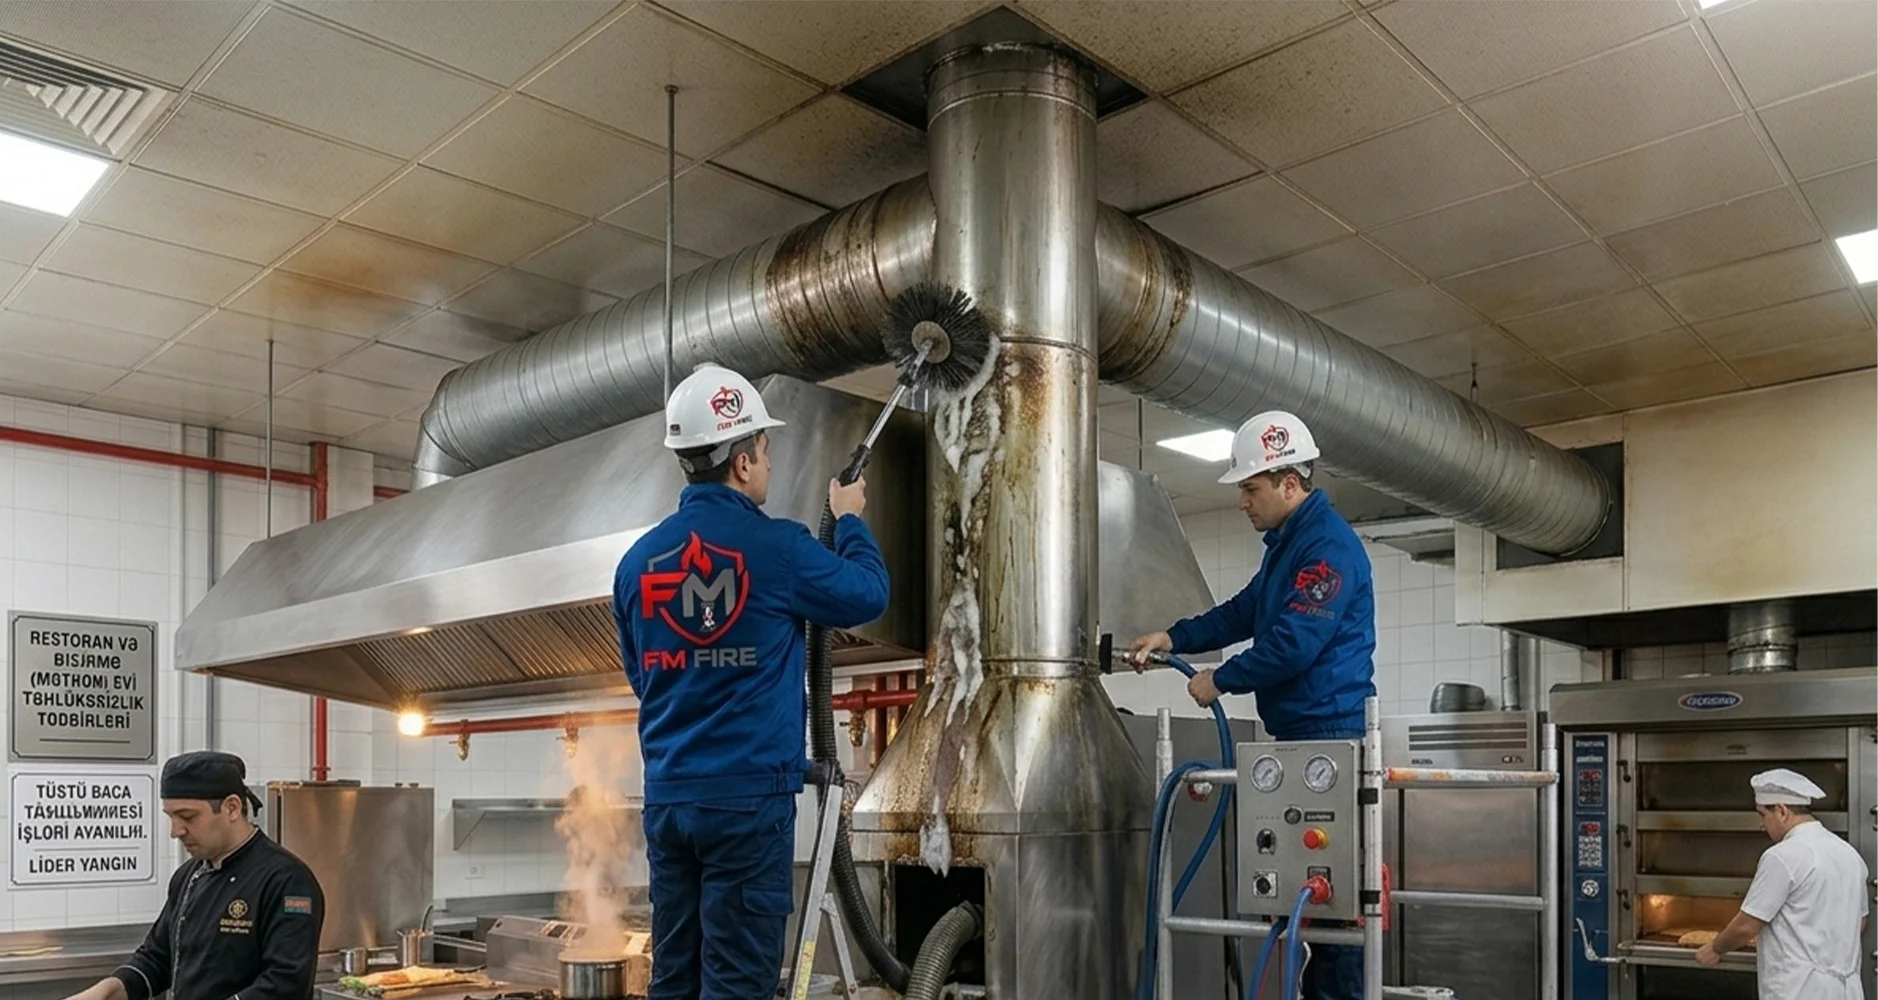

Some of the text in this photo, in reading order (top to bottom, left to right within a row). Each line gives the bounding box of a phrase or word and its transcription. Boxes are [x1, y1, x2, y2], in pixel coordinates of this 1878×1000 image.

[640, 568, 735, 619] FM
[30, 631, 113, 650] RESTORAN
[643, 646, 757, 671] FM FIRE
[92, 785, 132, 799] BACA
[29, 855, 137, 873] LİDER YANGIN
